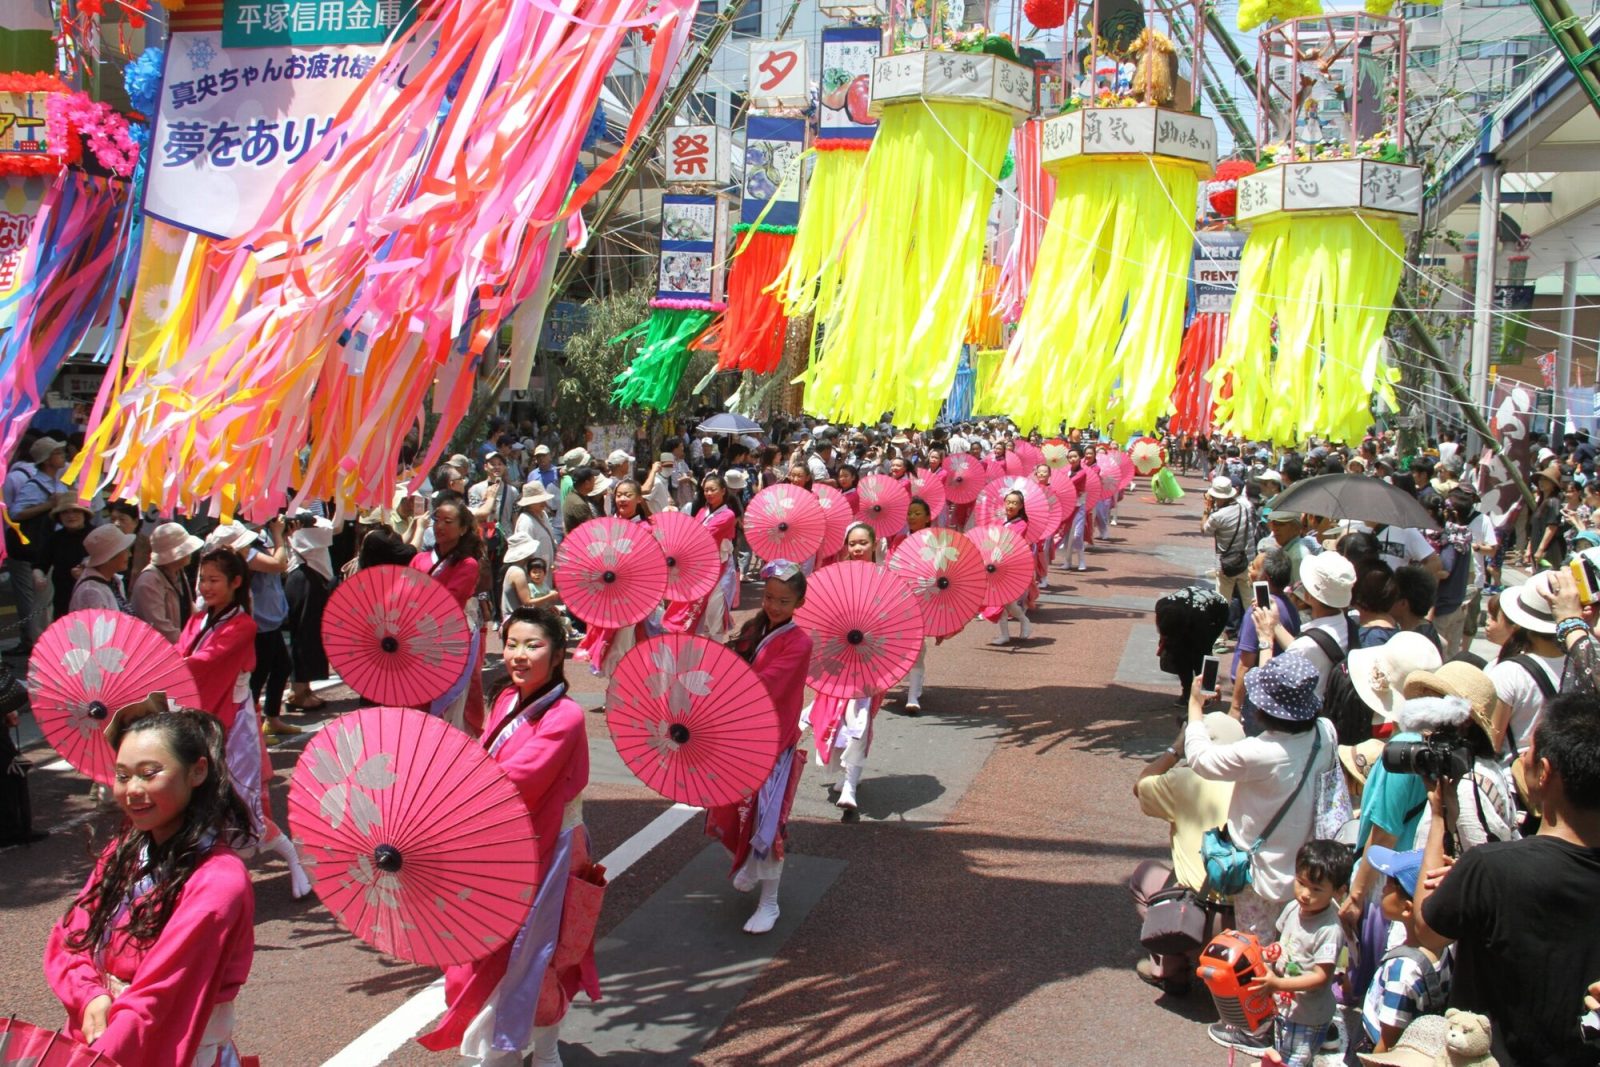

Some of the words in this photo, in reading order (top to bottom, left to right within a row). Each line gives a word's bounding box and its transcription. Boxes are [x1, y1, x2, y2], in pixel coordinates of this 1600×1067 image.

[236, 0, 401, 35] 平塚信用金庫
[169, 52, 408, 110] 真央ちゃんお疲れ様し
[758, 50, 798, 91] 夕
[1083, 111, 1135, 146] 勇気
[1158, 120, 1212, 151] 助け合い
[671, 133, 710, 176] 祭
[1362, 163, 1405, 204] 希望
[1200, 246, 1243, 258] RENT
